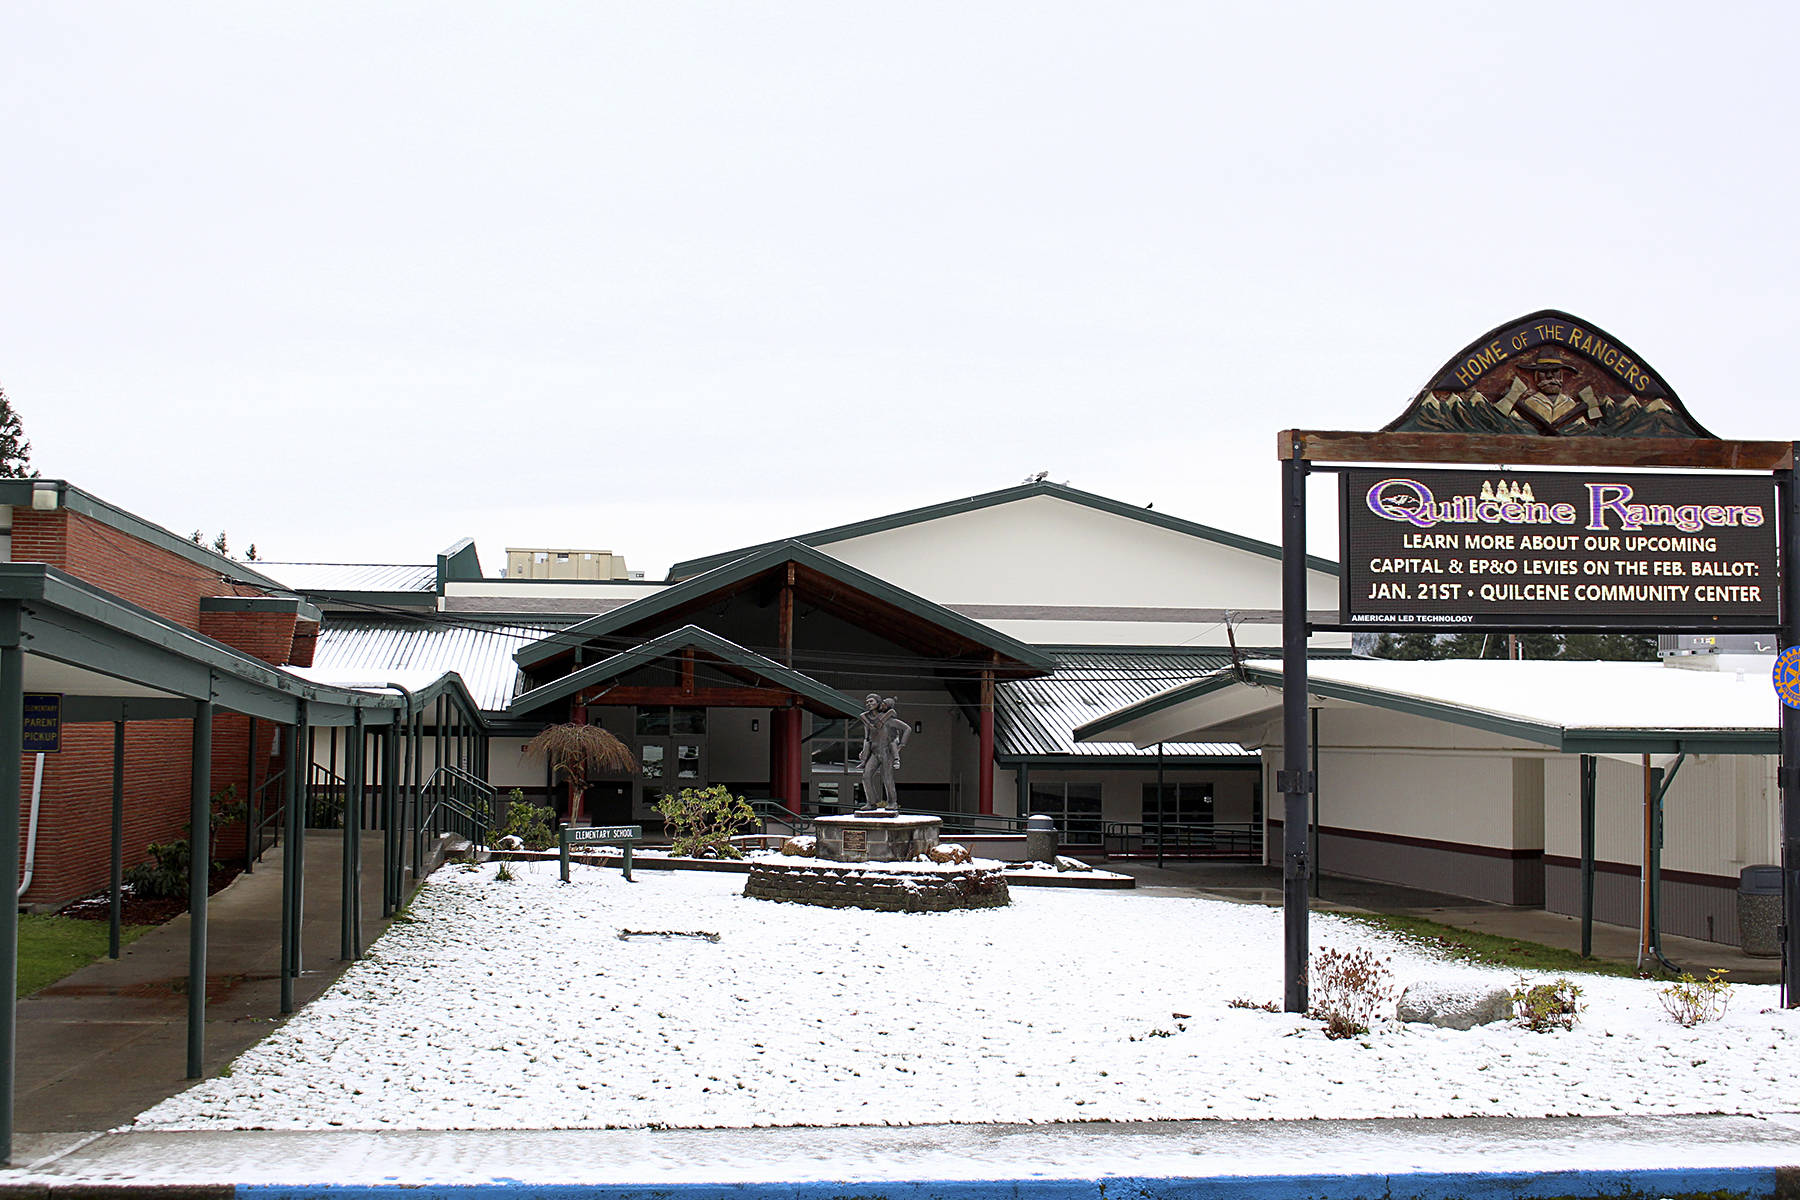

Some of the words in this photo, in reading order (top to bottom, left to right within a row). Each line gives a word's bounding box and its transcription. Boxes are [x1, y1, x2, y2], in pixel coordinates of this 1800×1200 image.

[1456, 340, 1508, 386] HOME
[1511, 331, 1529, 351] OF
[1534, 324, 1564, 341] THE
[1568, 327, 1652, 392] RANGERS
[1366, 478, 1577, 528] Quilcene
[1584, 483, 1765, 533] Rangers
[1403, 533, 1459, 550] LEARN
[1464, 534, 1515, 550] MORE
[1519, 535, 1580, 551] ABOUT
[1583, 536, 1622, 552] OUR
[1625, 536, 1717, 553] UPCOMING
[1369, 558, 1443, 574] CAPITAL
[1448, 559, 1464, 574] &
[1469, 559, 1518, 575] EP&O
[1523, 559, 1578, 575] LEVIES
[1583, 560, 1610, 576] ON
[1614, 560, 1648, 576] THE
[1653, 561, 1686, 576] FEB.
[1691, 561, 1759, 577] BALLOT:
[1368, 583, 1412, 600] JAN.
[1417, 583, 1462, 600] 21ST
[1479, 583, 1570, 602] QUILCENE
[1573, 584, 1690, 602] COMMUNITY
[1694, 585, 1762, 602] CENTER
[1351, 615, 1397, 623] AMERICAN
[1398, 615, 1414, 623] LED
[1415, 615, 1474, 623] TECHNOLOGY
[24, 718, 57, 727] PARENT
[24, 732, 57, 741] PICKUP
[575, 829, 610, 840] ELEMENTARY
[613, 828, 633, 838] SCHOOL
